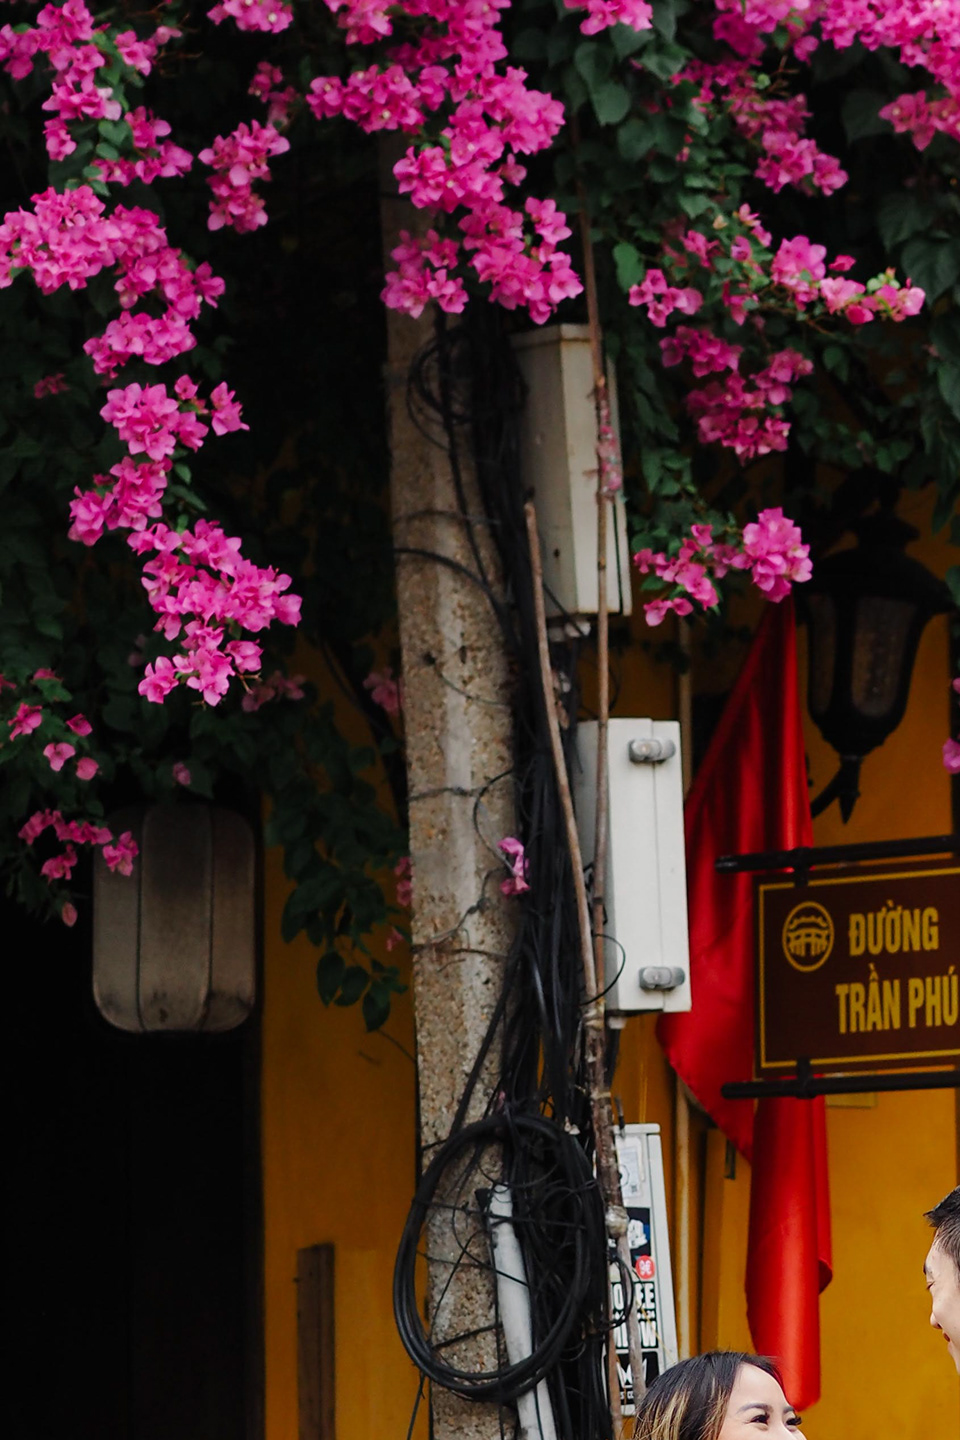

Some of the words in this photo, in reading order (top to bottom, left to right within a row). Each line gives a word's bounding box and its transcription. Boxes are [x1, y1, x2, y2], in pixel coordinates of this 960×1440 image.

[848, 899, 939, 957] ĐƯỜNG
[835, 962, 901, 1034] TRẦN
[908, 965, 959, 1028] PHÚ
